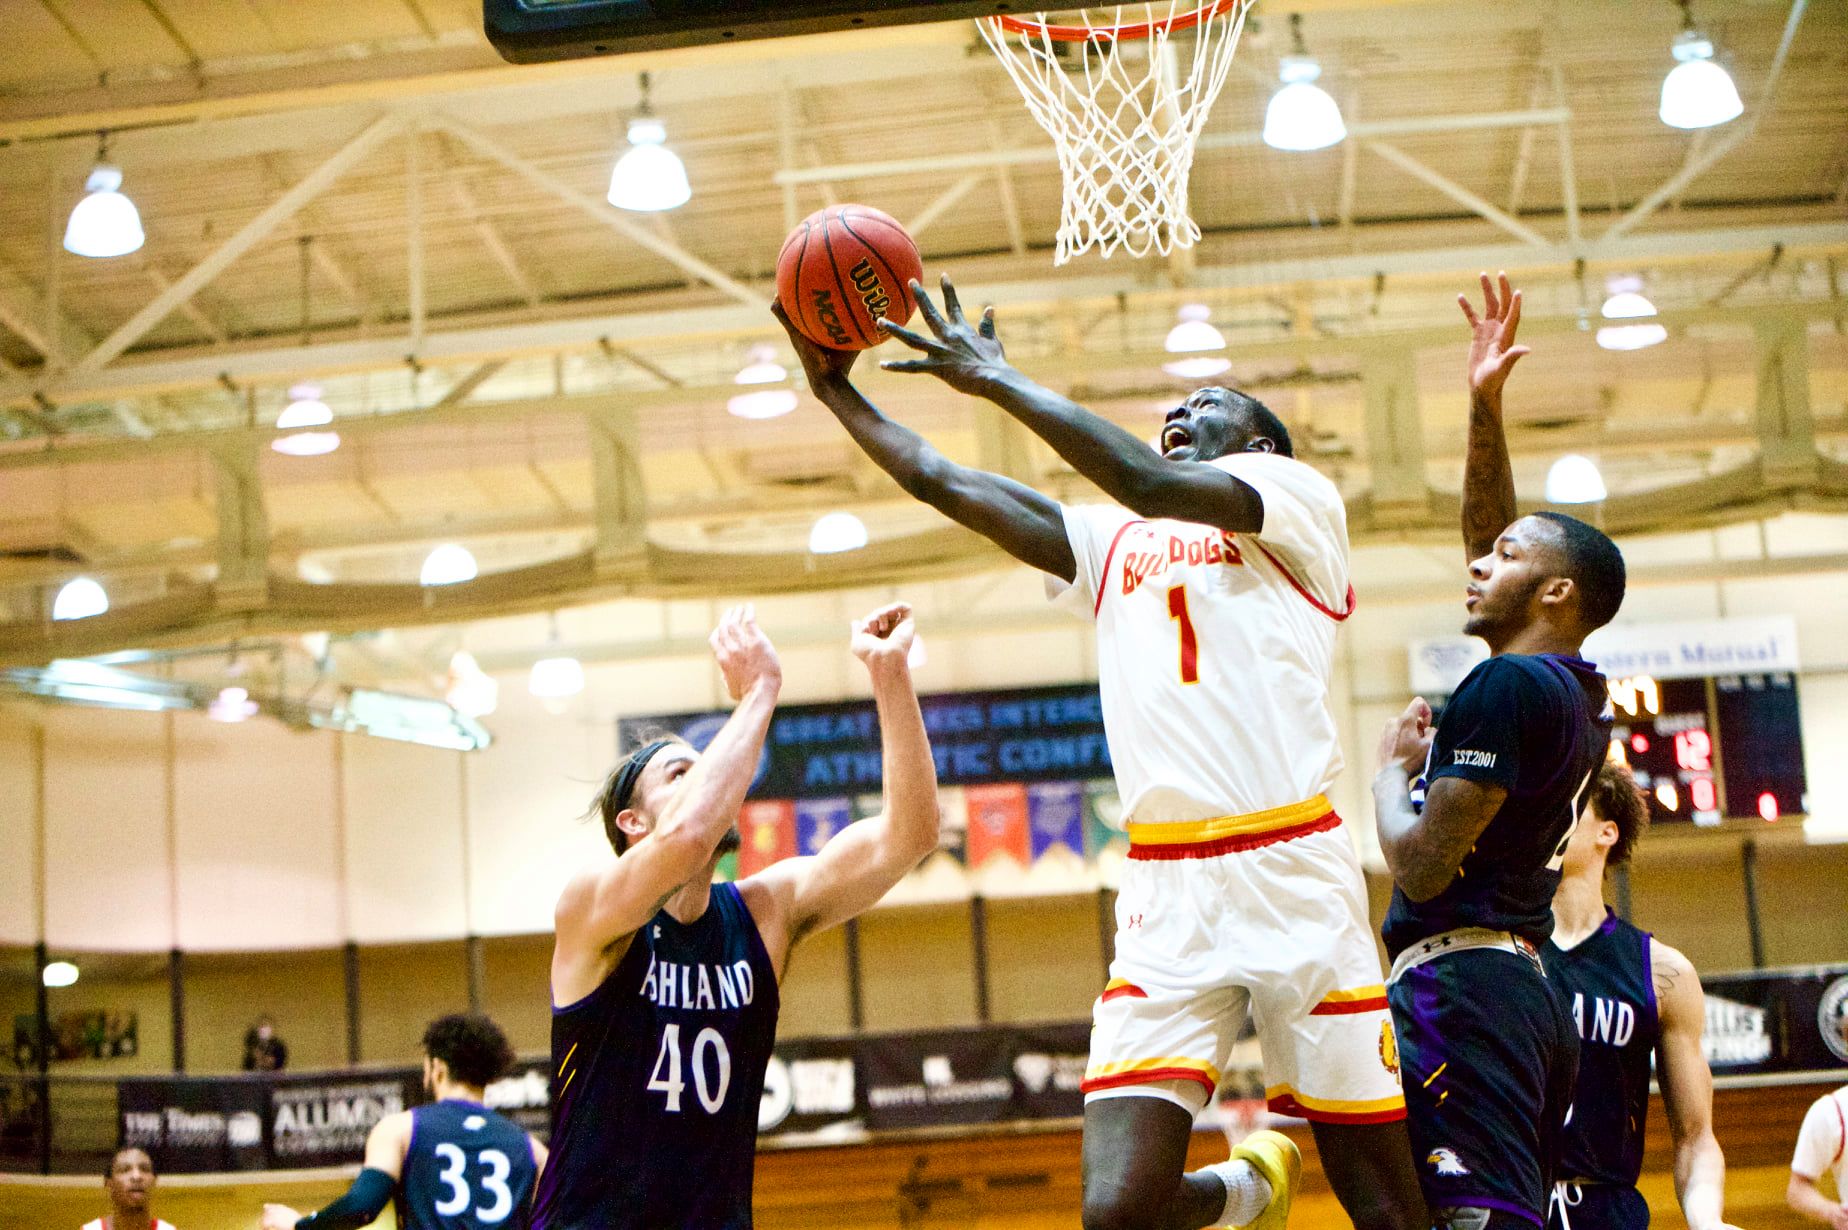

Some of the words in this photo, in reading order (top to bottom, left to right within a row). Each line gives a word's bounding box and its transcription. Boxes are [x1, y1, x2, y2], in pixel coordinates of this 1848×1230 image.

[1167, 583, 1199, 686] 1
[774, 711, 874, 746] GREAT
[1453, 749, 1497, 769] EST.2001
[1571, 992, 1635, 1047] AND
[646, 1023, 731, 1115] 40
[434, 1142, 513, 1225] 33
